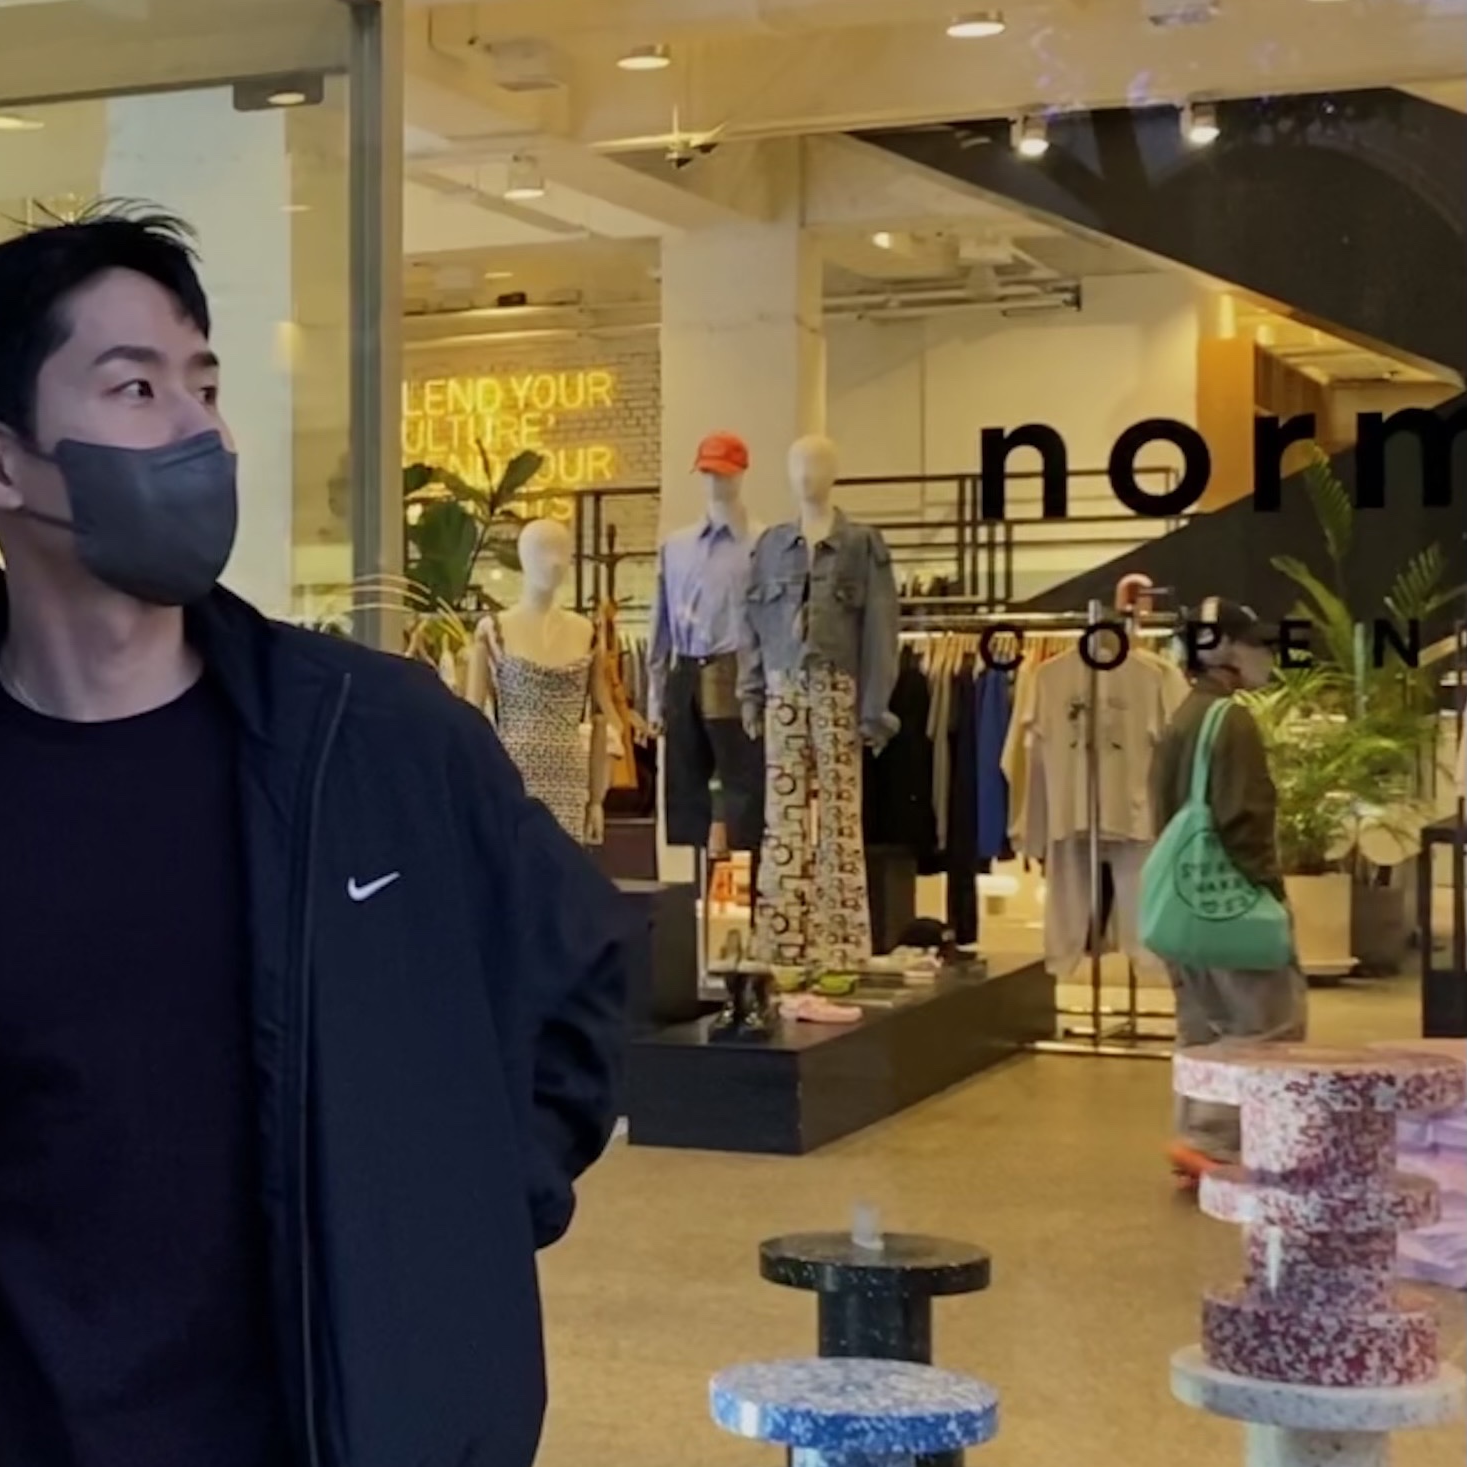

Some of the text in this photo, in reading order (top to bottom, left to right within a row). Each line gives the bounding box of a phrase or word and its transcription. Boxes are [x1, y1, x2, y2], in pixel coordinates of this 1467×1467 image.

[511, 370, 613, 411] YOUR
[531, 446, 613, 482] OUR
[979, 406, 1467, 520] norm
[979, 617, 1421, 671] COPEN
